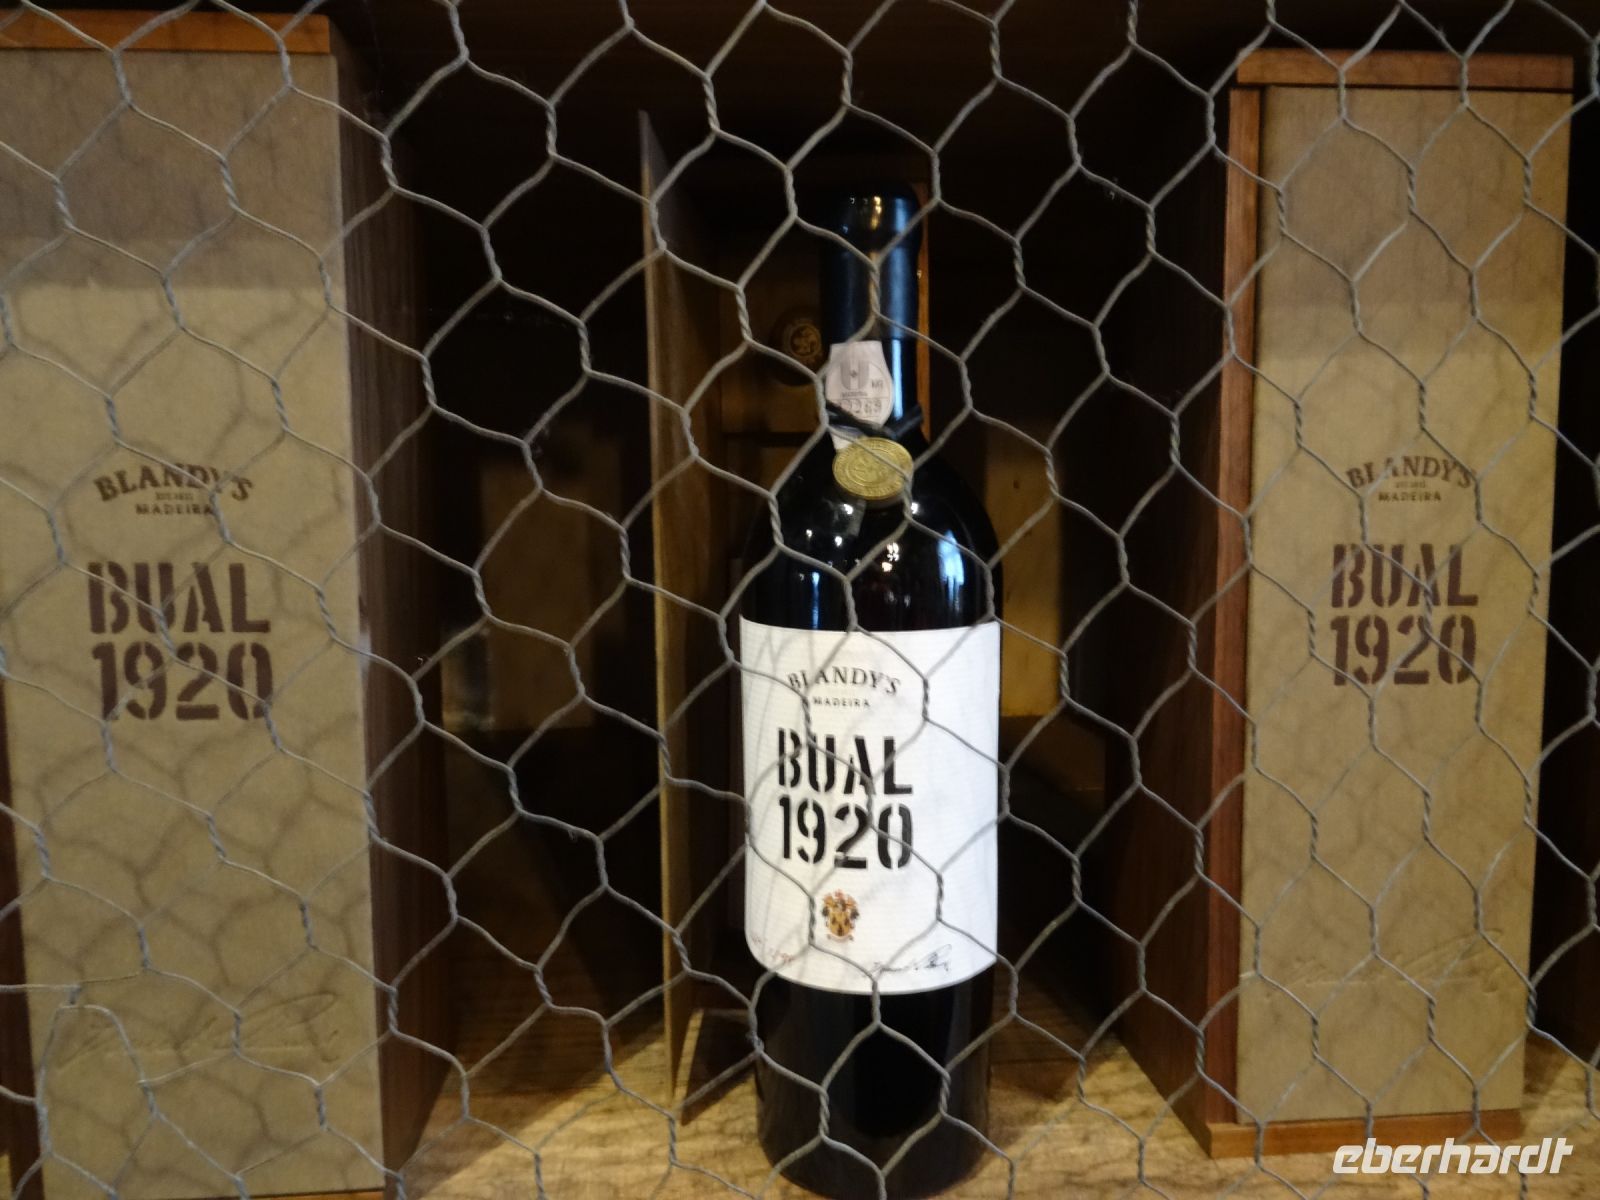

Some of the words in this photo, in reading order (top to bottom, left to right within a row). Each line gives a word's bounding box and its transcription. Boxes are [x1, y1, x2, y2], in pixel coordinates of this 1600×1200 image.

[94, 463, 253, 501] BLANDYS
[1346, 456, 1477, 489] BLANDYS
[1378, 491, 1441, 502] MADEIRA
[136, 503, 214, 515] MADEIRA
[88, 561, 271, 634] BUAL
[1331, 543, 1479, 608] BUAL
[92, 641, 274, 721] 1920
[1330, 615, 1477, 687] 1920
[813, 696, 870, 707] MADEIRA
[778, 728, 914, 795] BUAL
[779, 795, 913, 870] 1920
